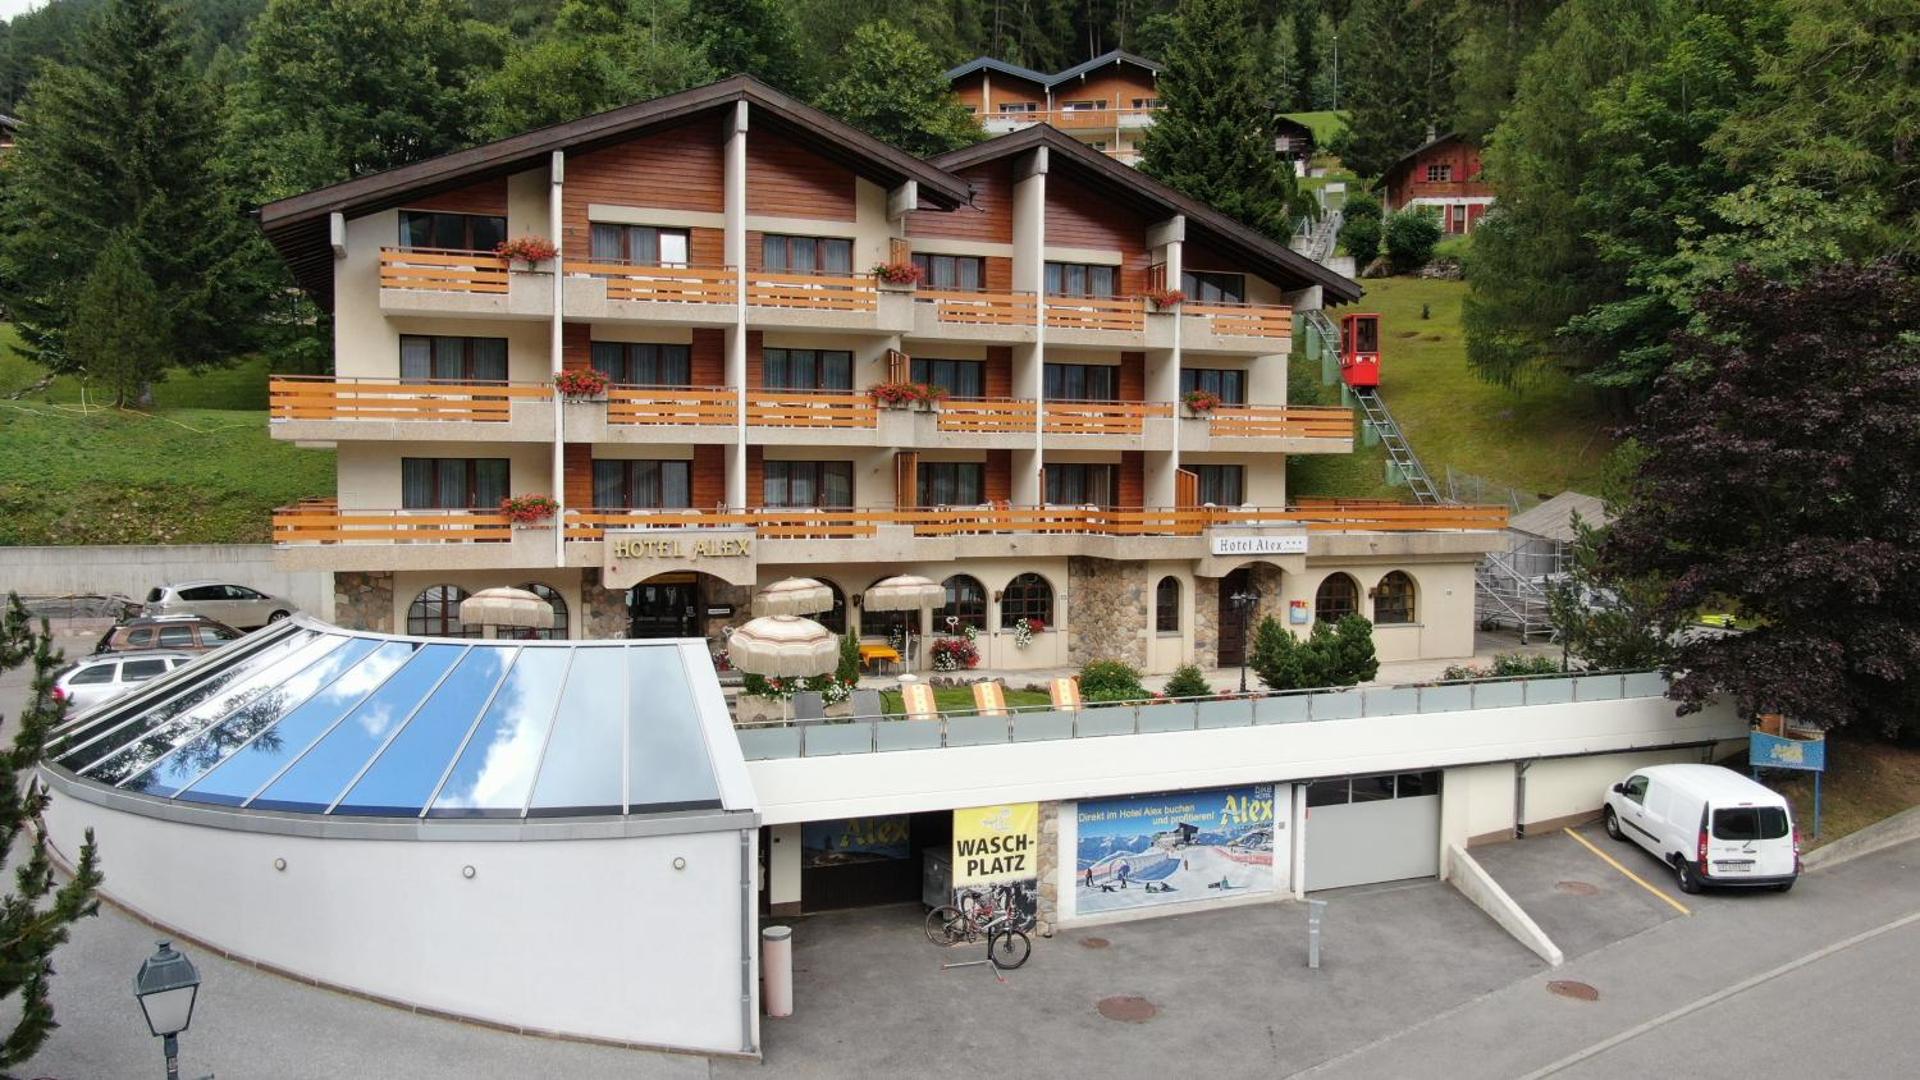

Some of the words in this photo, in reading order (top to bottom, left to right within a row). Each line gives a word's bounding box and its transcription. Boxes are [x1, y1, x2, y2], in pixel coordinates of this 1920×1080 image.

[614, 539, 685, 559] HOTEL
[690, 538, 751, 562] ALEX
[1220, 539, 1252, 552] Hotel
[1256, 539, 1282, 551] Alex
[1078, 811, 1105, 823] Direkt
[1107, 808, 1117, 819] im
[1119, 806, 1142, 818] Hotel
[1143, 806, 1162, 816] Alex
[1164, 803, 1195, 815] buchen
[1152, 814, 1169, 825] und
[1170, 811, 1216, 826] profitieren!
[1220, 794, 1273, 826] Alex
[956, 833, 1035, 857] WASCH-
[967, 855, 1026, 877] PLATZ
